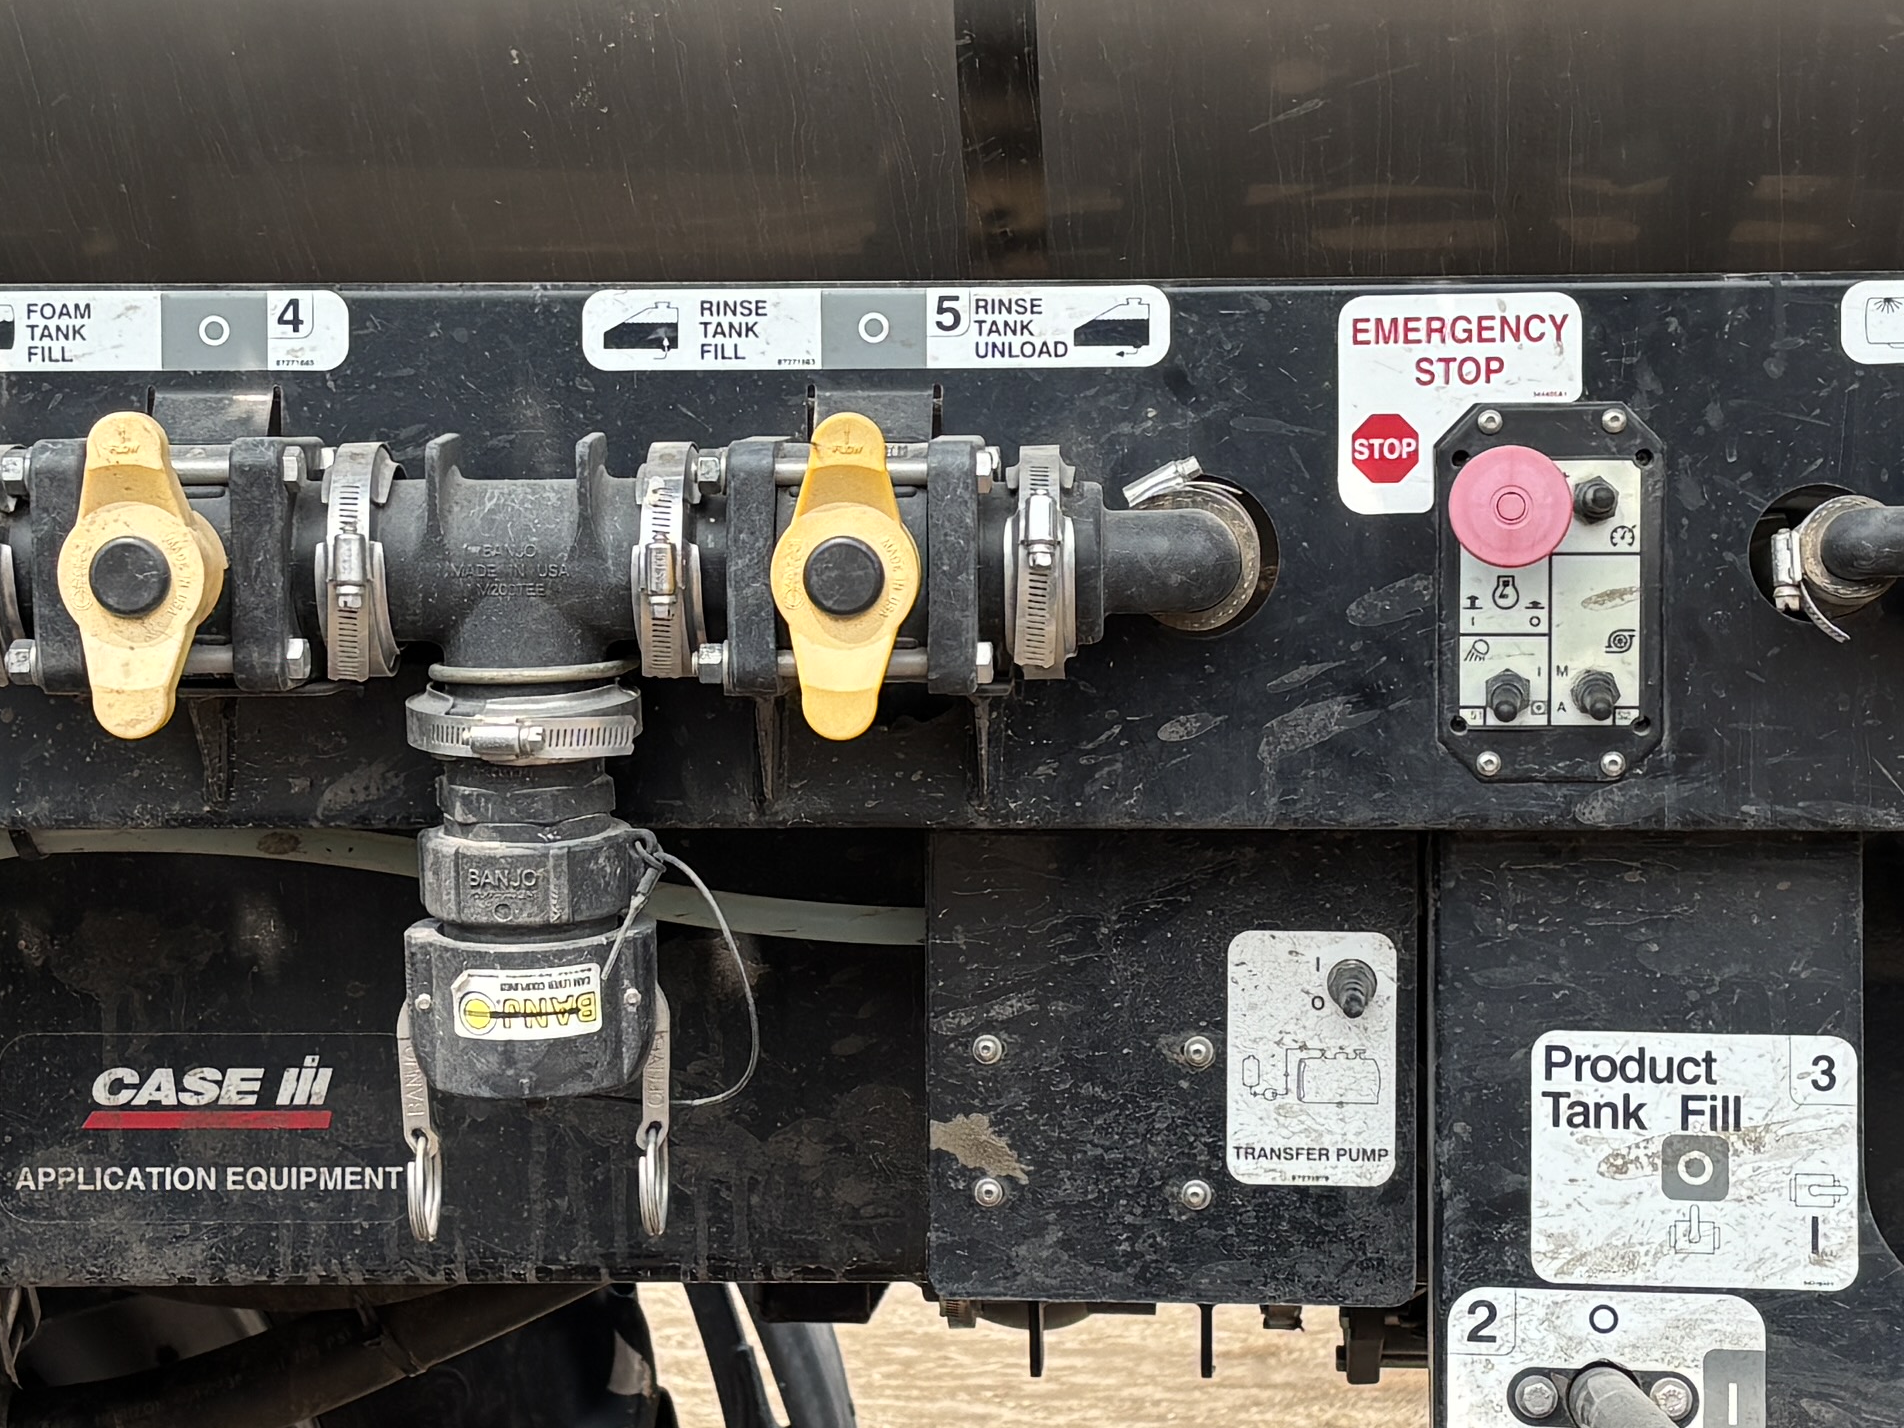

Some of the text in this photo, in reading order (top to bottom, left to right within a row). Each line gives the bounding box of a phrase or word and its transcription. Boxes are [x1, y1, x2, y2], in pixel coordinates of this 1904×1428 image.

[27, 303, 90, 319] FOAM
[278, 299, 303, 332] 4
[701, 300, 767, 317] RINSE
[936, 296, 961, 331] 5
[976, 298, 1042, 315] RINSE
[26, 324, 86, 341] TANK
[699, 322, 758, 338] TANK
[974, 320, 1034, 336] TANK
[1353, 314, 1568, 347] EMERGENCY
[28, 346, 73, 362] FILL
[701, 344, 745, 360] FILL
[976, 341, 1067, 358] UNLOAD
[1416, 357, 1504, 386] STOP
[1354, 438, 1416, 460] STOP
[1557, 665, 1568, 677] M
[1557, 702, 1566, 712] A
[468, 868, 536, 887] BANJO
[1545, 1045, 1717, 1085] Product
[1811, 1055, 1836, 1091] 3
[92, 1068, 264, 1105] CASE
[1542, 1091, 1741, 1132] Tank Fill
[1233, 1146, 1388, 1162] TRANSFER PUMP
[16, 1167, 403, 1190] APPLICATION EQUIPMENT
[1467, 1300, 1497, 1343] 2
